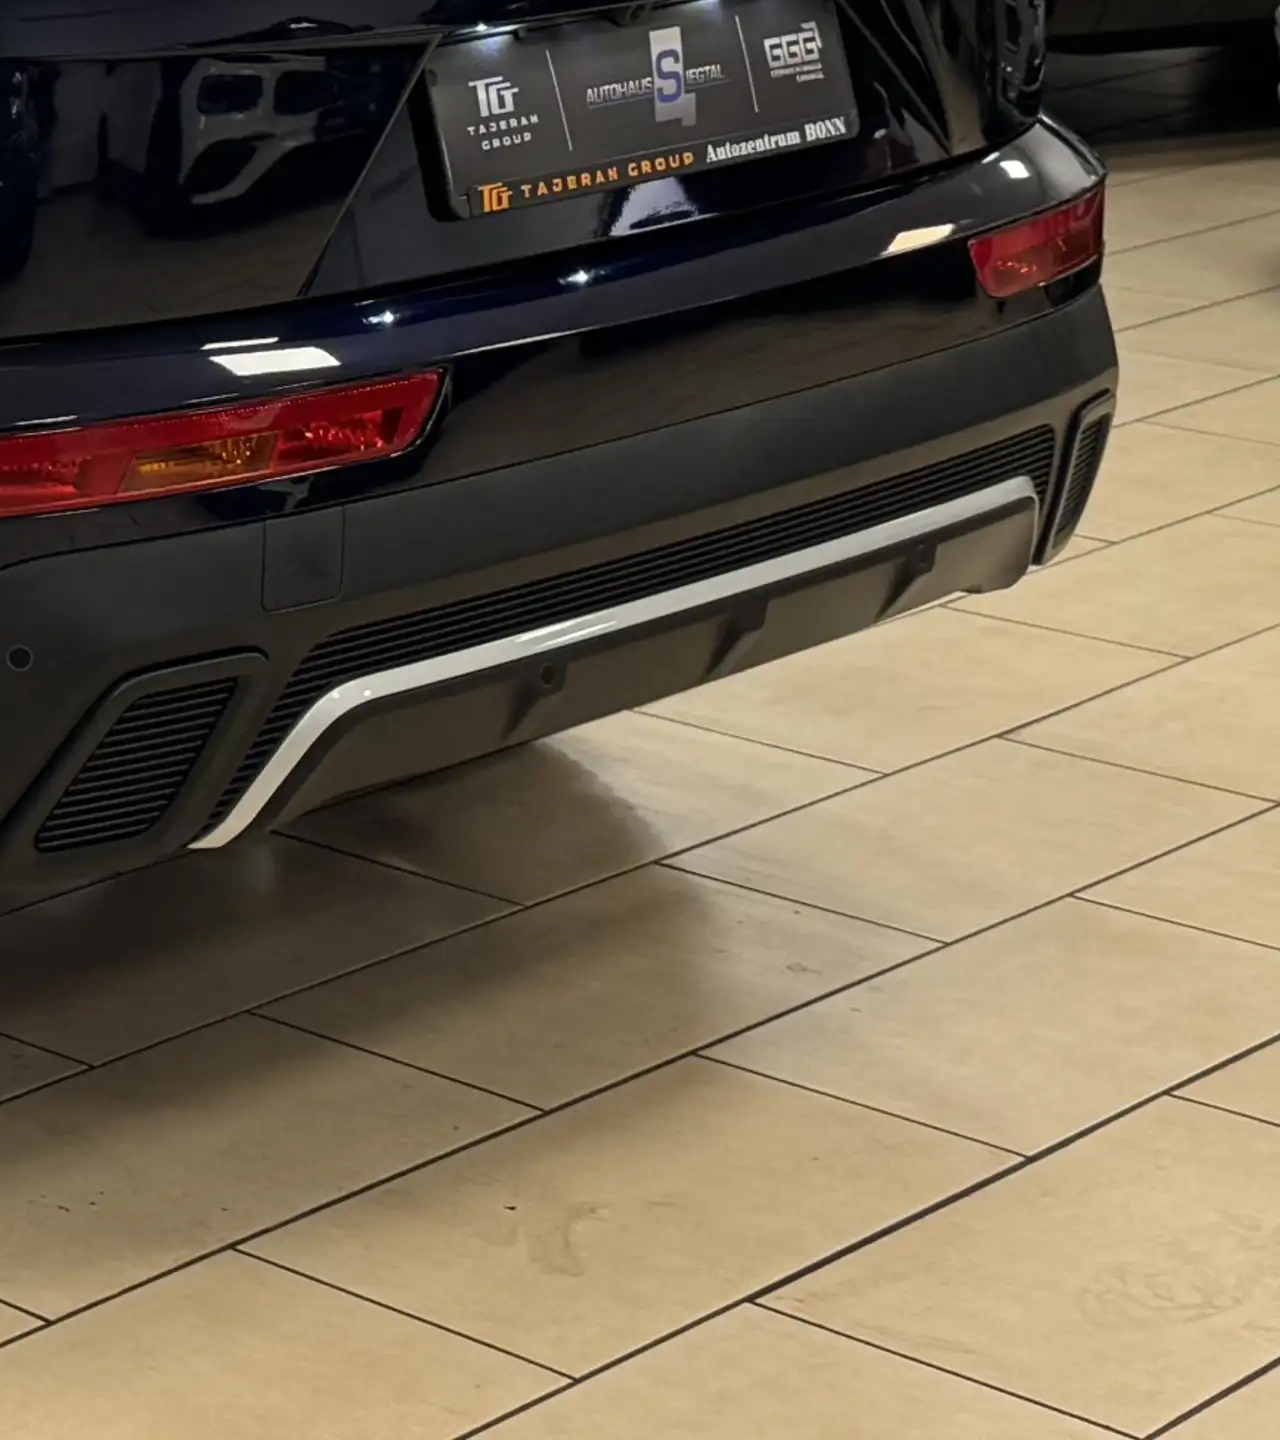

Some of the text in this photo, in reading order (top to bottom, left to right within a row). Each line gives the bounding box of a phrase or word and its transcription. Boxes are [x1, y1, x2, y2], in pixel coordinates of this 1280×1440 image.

[586, 76, 653, 105] AUTOHAUS
[467, 114, 539, 136] TAJERAN
[481, 131, 532, 151] GROUP
[705, 116, 848, 164] Autozentrum BONN
[520, 166, 620, 199] TAJERAN
[627, 151, 696, 178] GROUP
